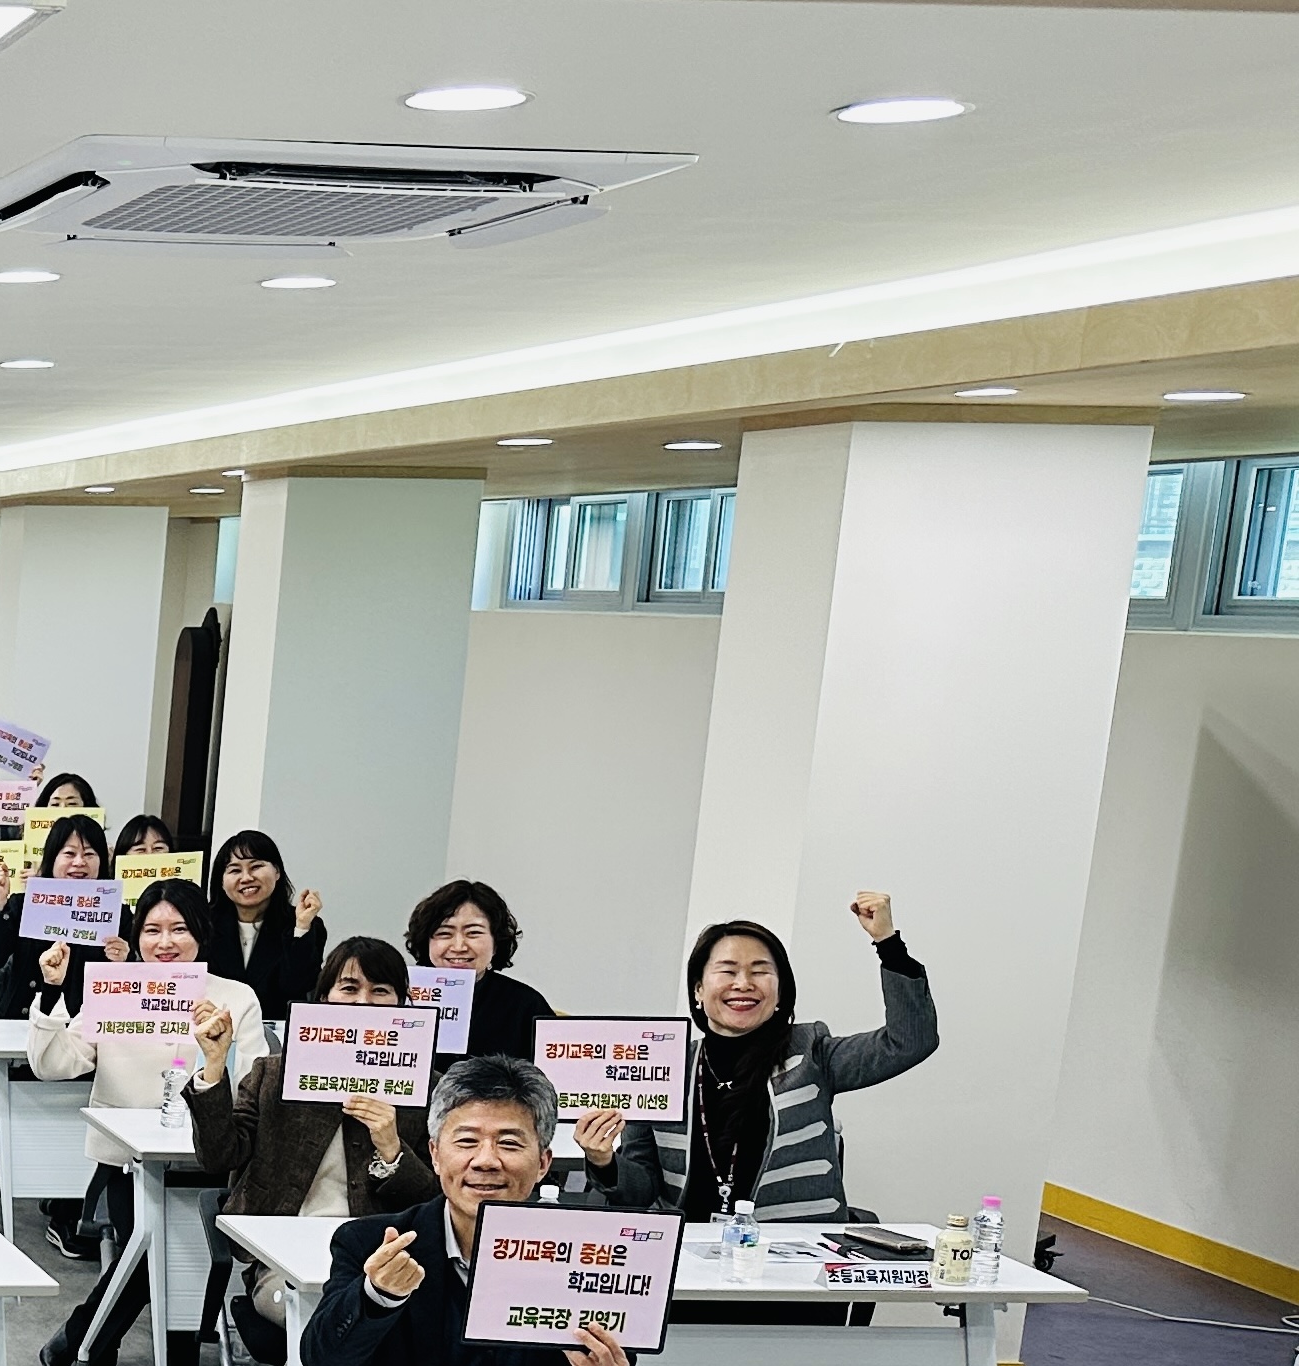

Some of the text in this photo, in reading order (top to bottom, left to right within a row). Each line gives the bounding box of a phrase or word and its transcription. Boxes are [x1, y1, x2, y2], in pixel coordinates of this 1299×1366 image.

[32, 893, 100, 907] 경기교육의 중심은
[71, 911, 113, 923] 학교입니다!
[92, 982, 176, 995] 경기교육의 중심은
[96, 1021, 155, 1034] 기획경영팀장
[299, 1027, 398, 1046] 경기교육의 중심은
[356, 1050, 417, 1068] 학교입니다!
[546, 1044, 649, 1061] 경기교육의 중심은
[606, 1065, 670, 1082] 학교입니다!
[299, 1075, 379, 1093] 중등교육지원과장
[557, 1093, 631, 1110] 등교육지원과장
[493, 1239, 627, 1266] 경기교육의 중심은
[568, 1271, 651, 1296] 학교입니다!
[828, 1270, 928, 1285] 초등교육지원과장
[507, 1306, 572, 1329] 교육국장
